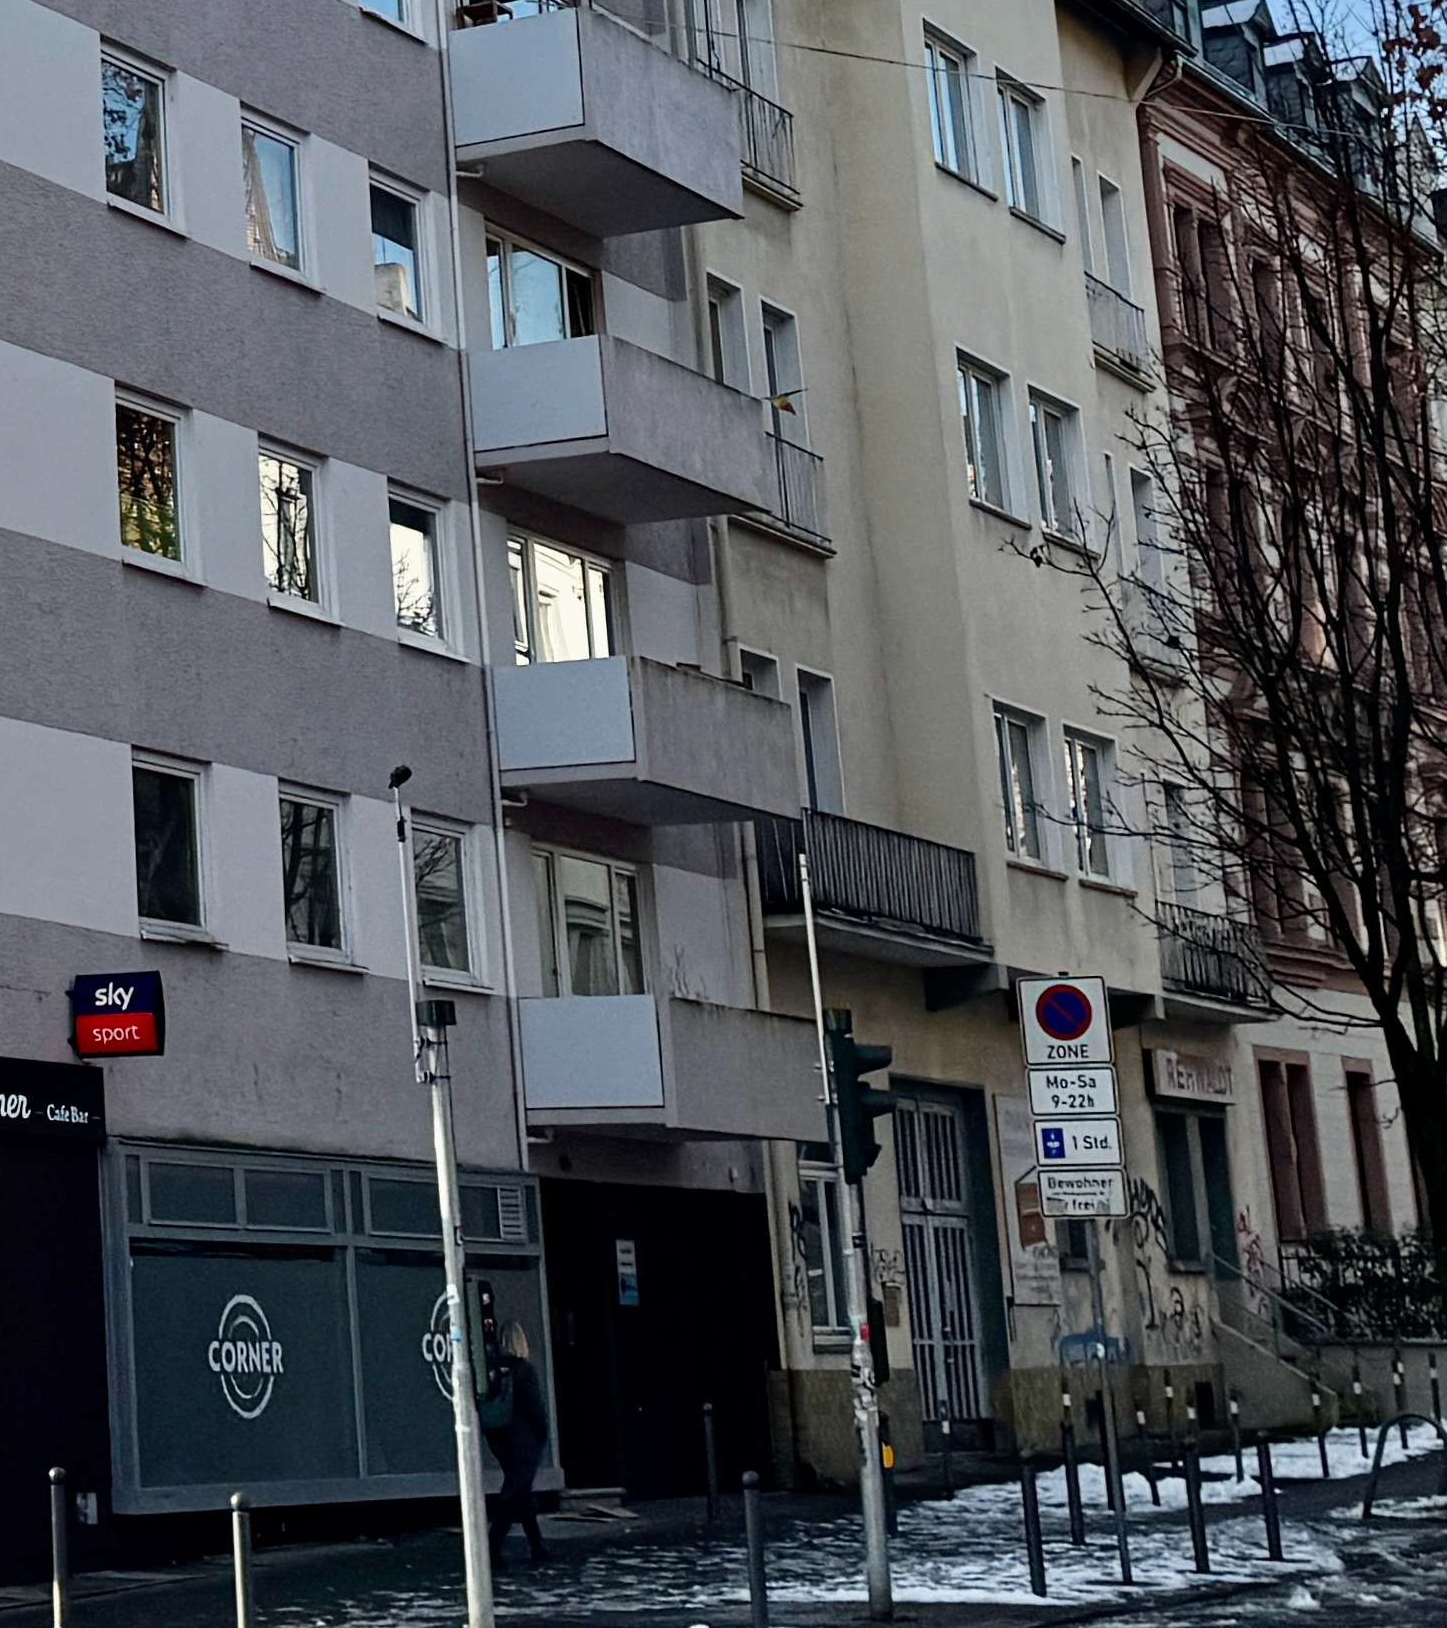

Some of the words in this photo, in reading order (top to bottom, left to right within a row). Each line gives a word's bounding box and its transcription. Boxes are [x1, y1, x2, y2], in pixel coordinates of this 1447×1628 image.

[94, 982, 134, 1010] sky
[92, 1025, 141, 1044] sport
[1047, 1044, 1090, 1059] ZONE
[1046, 1075, 1097, 1089] Mo-Sa
[1051, 1094, 1095, 1109] 9-22h
[70, 1105, 89, 1123] Bar
[1072, 1135, 1079, 1150] 1
[208, 1340, 284, 1373] CORNER
